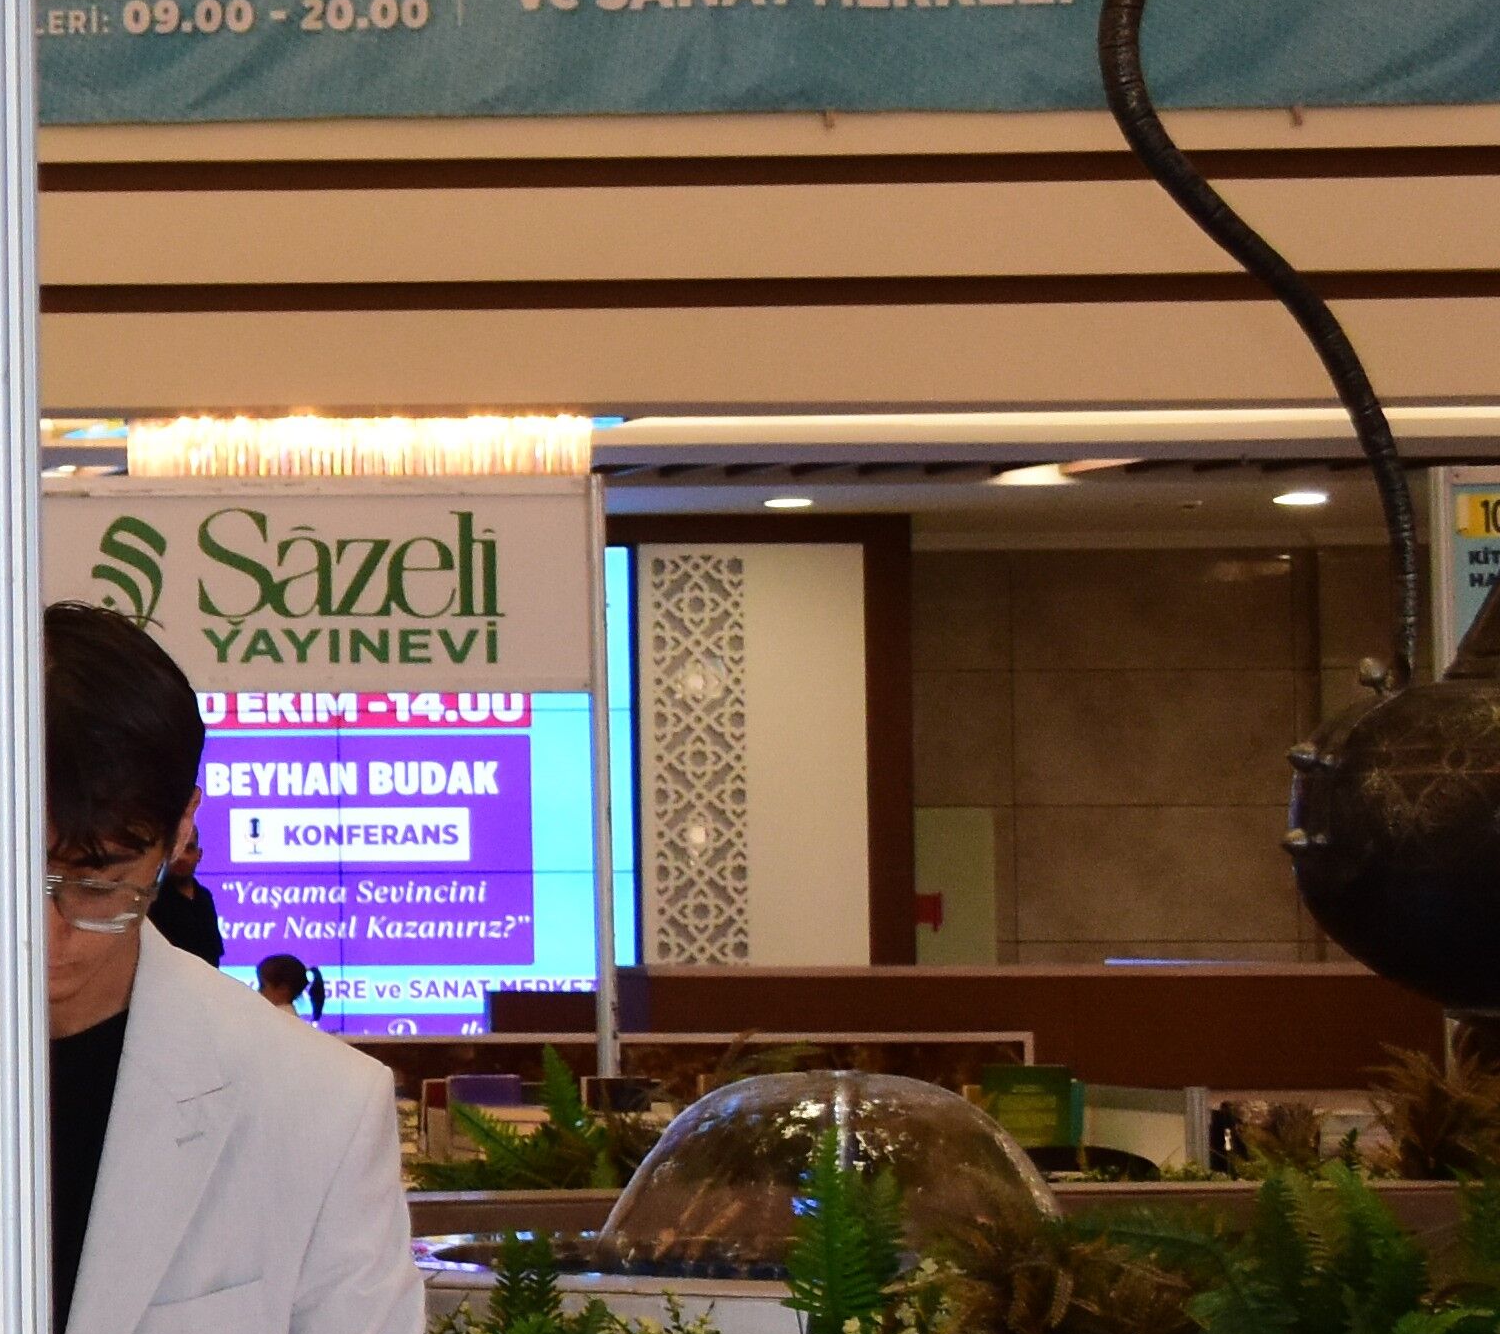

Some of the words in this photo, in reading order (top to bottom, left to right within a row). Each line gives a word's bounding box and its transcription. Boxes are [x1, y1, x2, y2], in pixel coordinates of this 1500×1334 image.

[202, 620, 498, 664] YAYINEVİ
[205, 761, 359, 798] BEYHAN
[369, 759, 499, 796] BUDAK
[284, 823, 460, 847] KONFERANS
[356, 878, 488, 905] Sevincini
[284, 915, 357, 940] Nasıl
[375, 981, 401, 1000] ve
[409, 979, 491, 1000] SANAT
